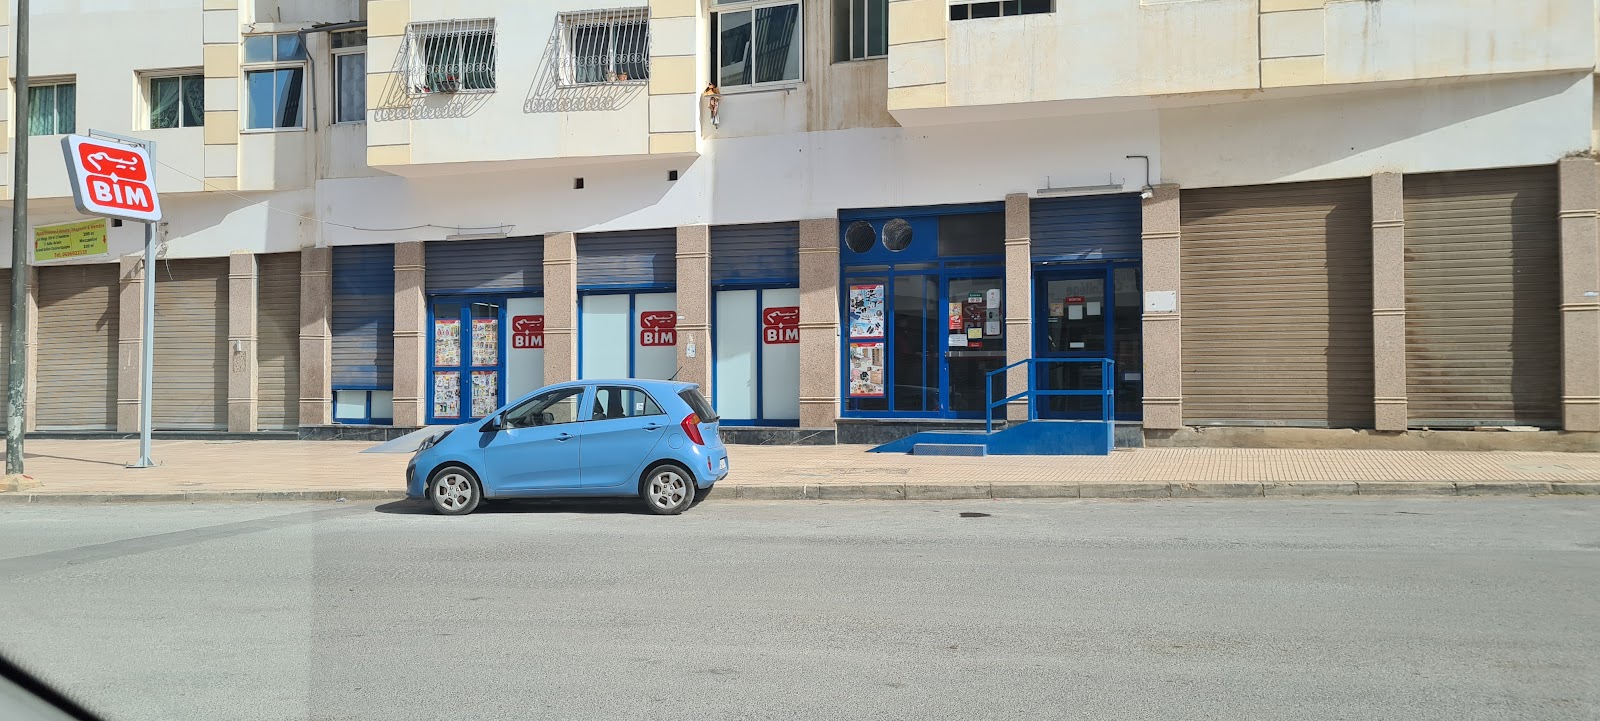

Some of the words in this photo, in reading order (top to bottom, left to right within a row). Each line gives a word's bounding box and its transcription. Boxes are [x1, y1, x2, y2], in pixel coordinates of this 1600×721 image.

[87, 152, 138, 171] بيم
[644, 314, 673, 326] بيم
[767, 310, 798, 323] بيم
[516, 318, 543, 330] بيم
